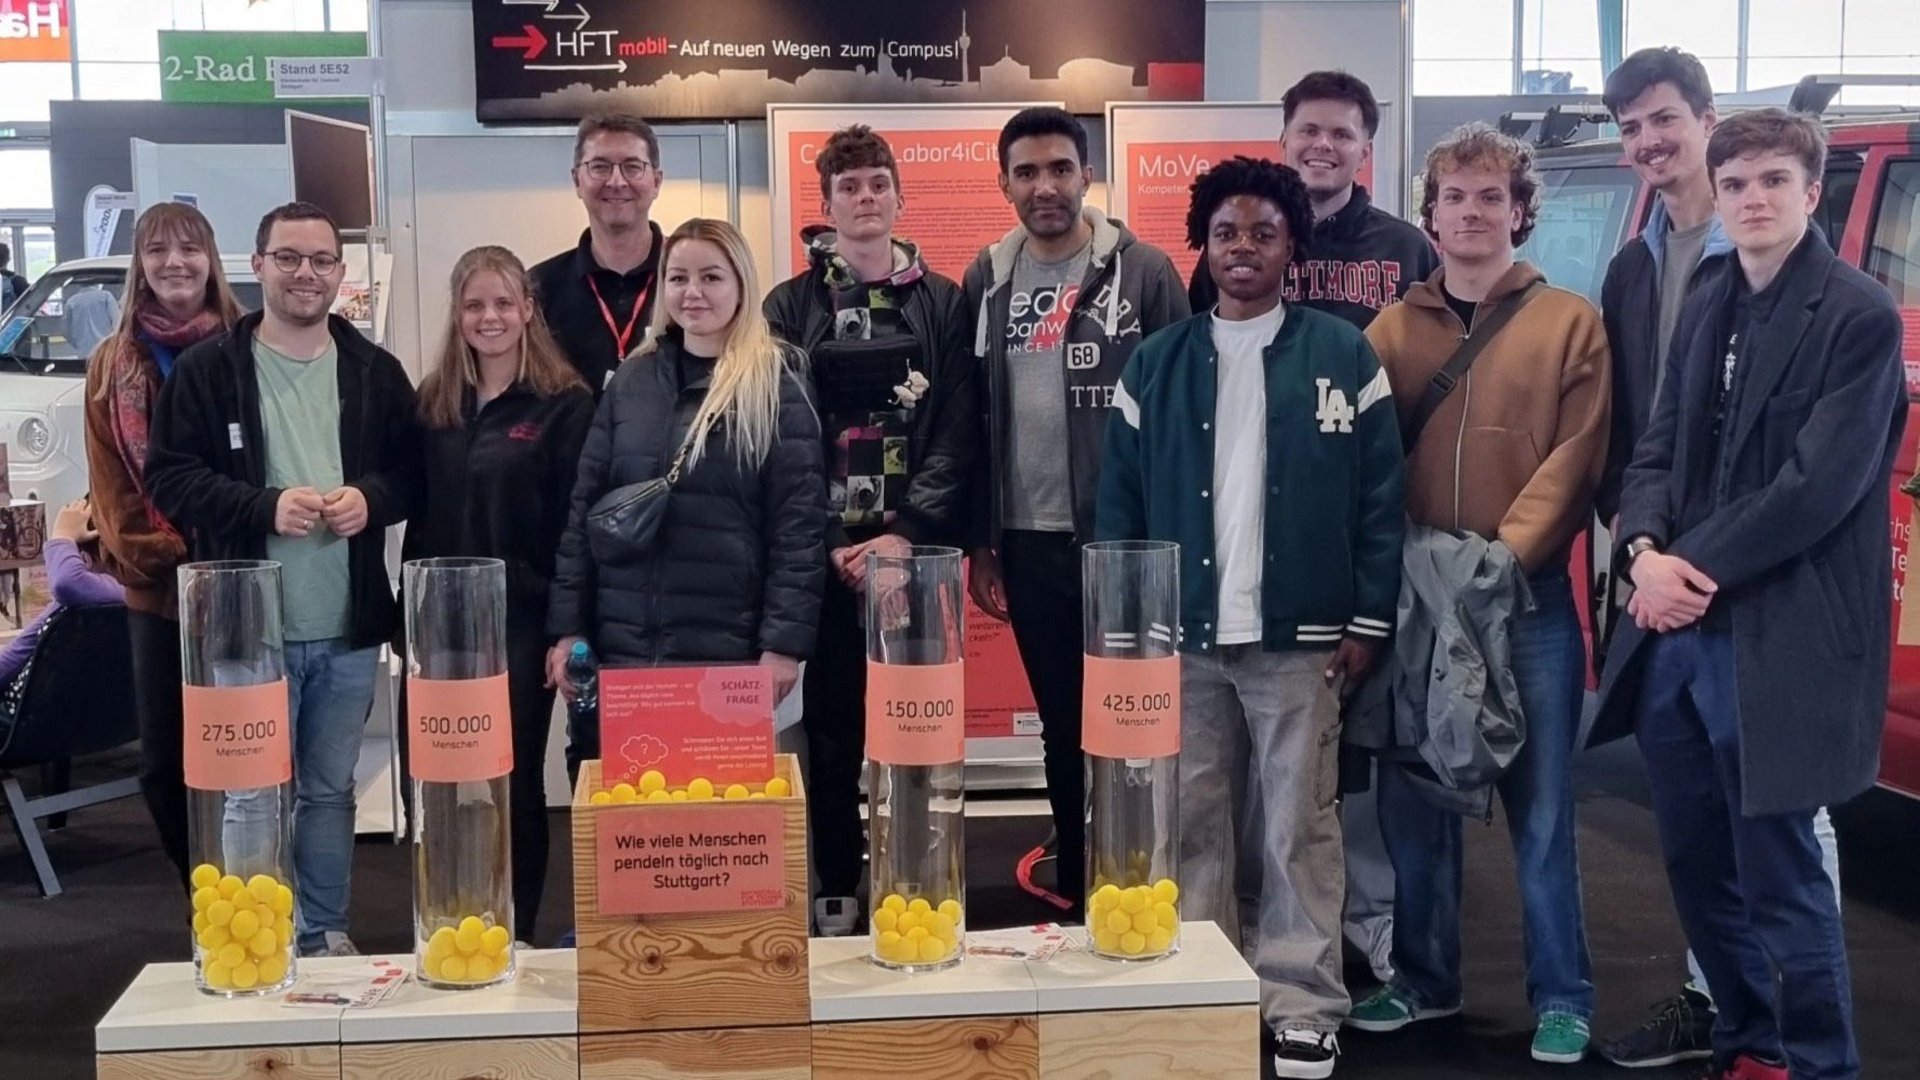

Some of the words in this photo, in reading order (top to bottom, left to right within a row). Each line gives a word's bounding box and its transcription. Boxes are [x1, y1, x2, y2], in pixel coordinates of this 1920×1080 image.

[556, 30, 619, 56] HFT
[713, 43, 765, 57] neuen
[772, 40, 831, 59] Wegen
[840, 44, 875, 57] zum
[165, 55, 257, 82] 2-Rad
[280, 63, 316, 75] Stand
[320, 63, 350, 75] 5E52
[1072, 345, 1094, 366] 68
[1315, 378, 1354, 433] LA
[885, 699, 954, 719] 150.000
[1102, 692, 1171, 712] 425.000
[202, 719, 276, 742] 275.000
[420, 714, 491, 735] 500.000
[898, 722, 943, 733] Menschen
[1116, 716, 1160, 727] Menschen
[216, 746, 265, 757] Menschen
[432, 740, 479, 750] Menschen
[615, 835, 645, 849] Wie
[649, 834, 684, 848] viele
[688, 831, 767, 847] Menschen
[614, 855, 674, 872] pendeln
[679, 853, 728, 870] täglich
[733, 851, 769, 866] nach
[653, 872, 731, 891] Stuttgart?
